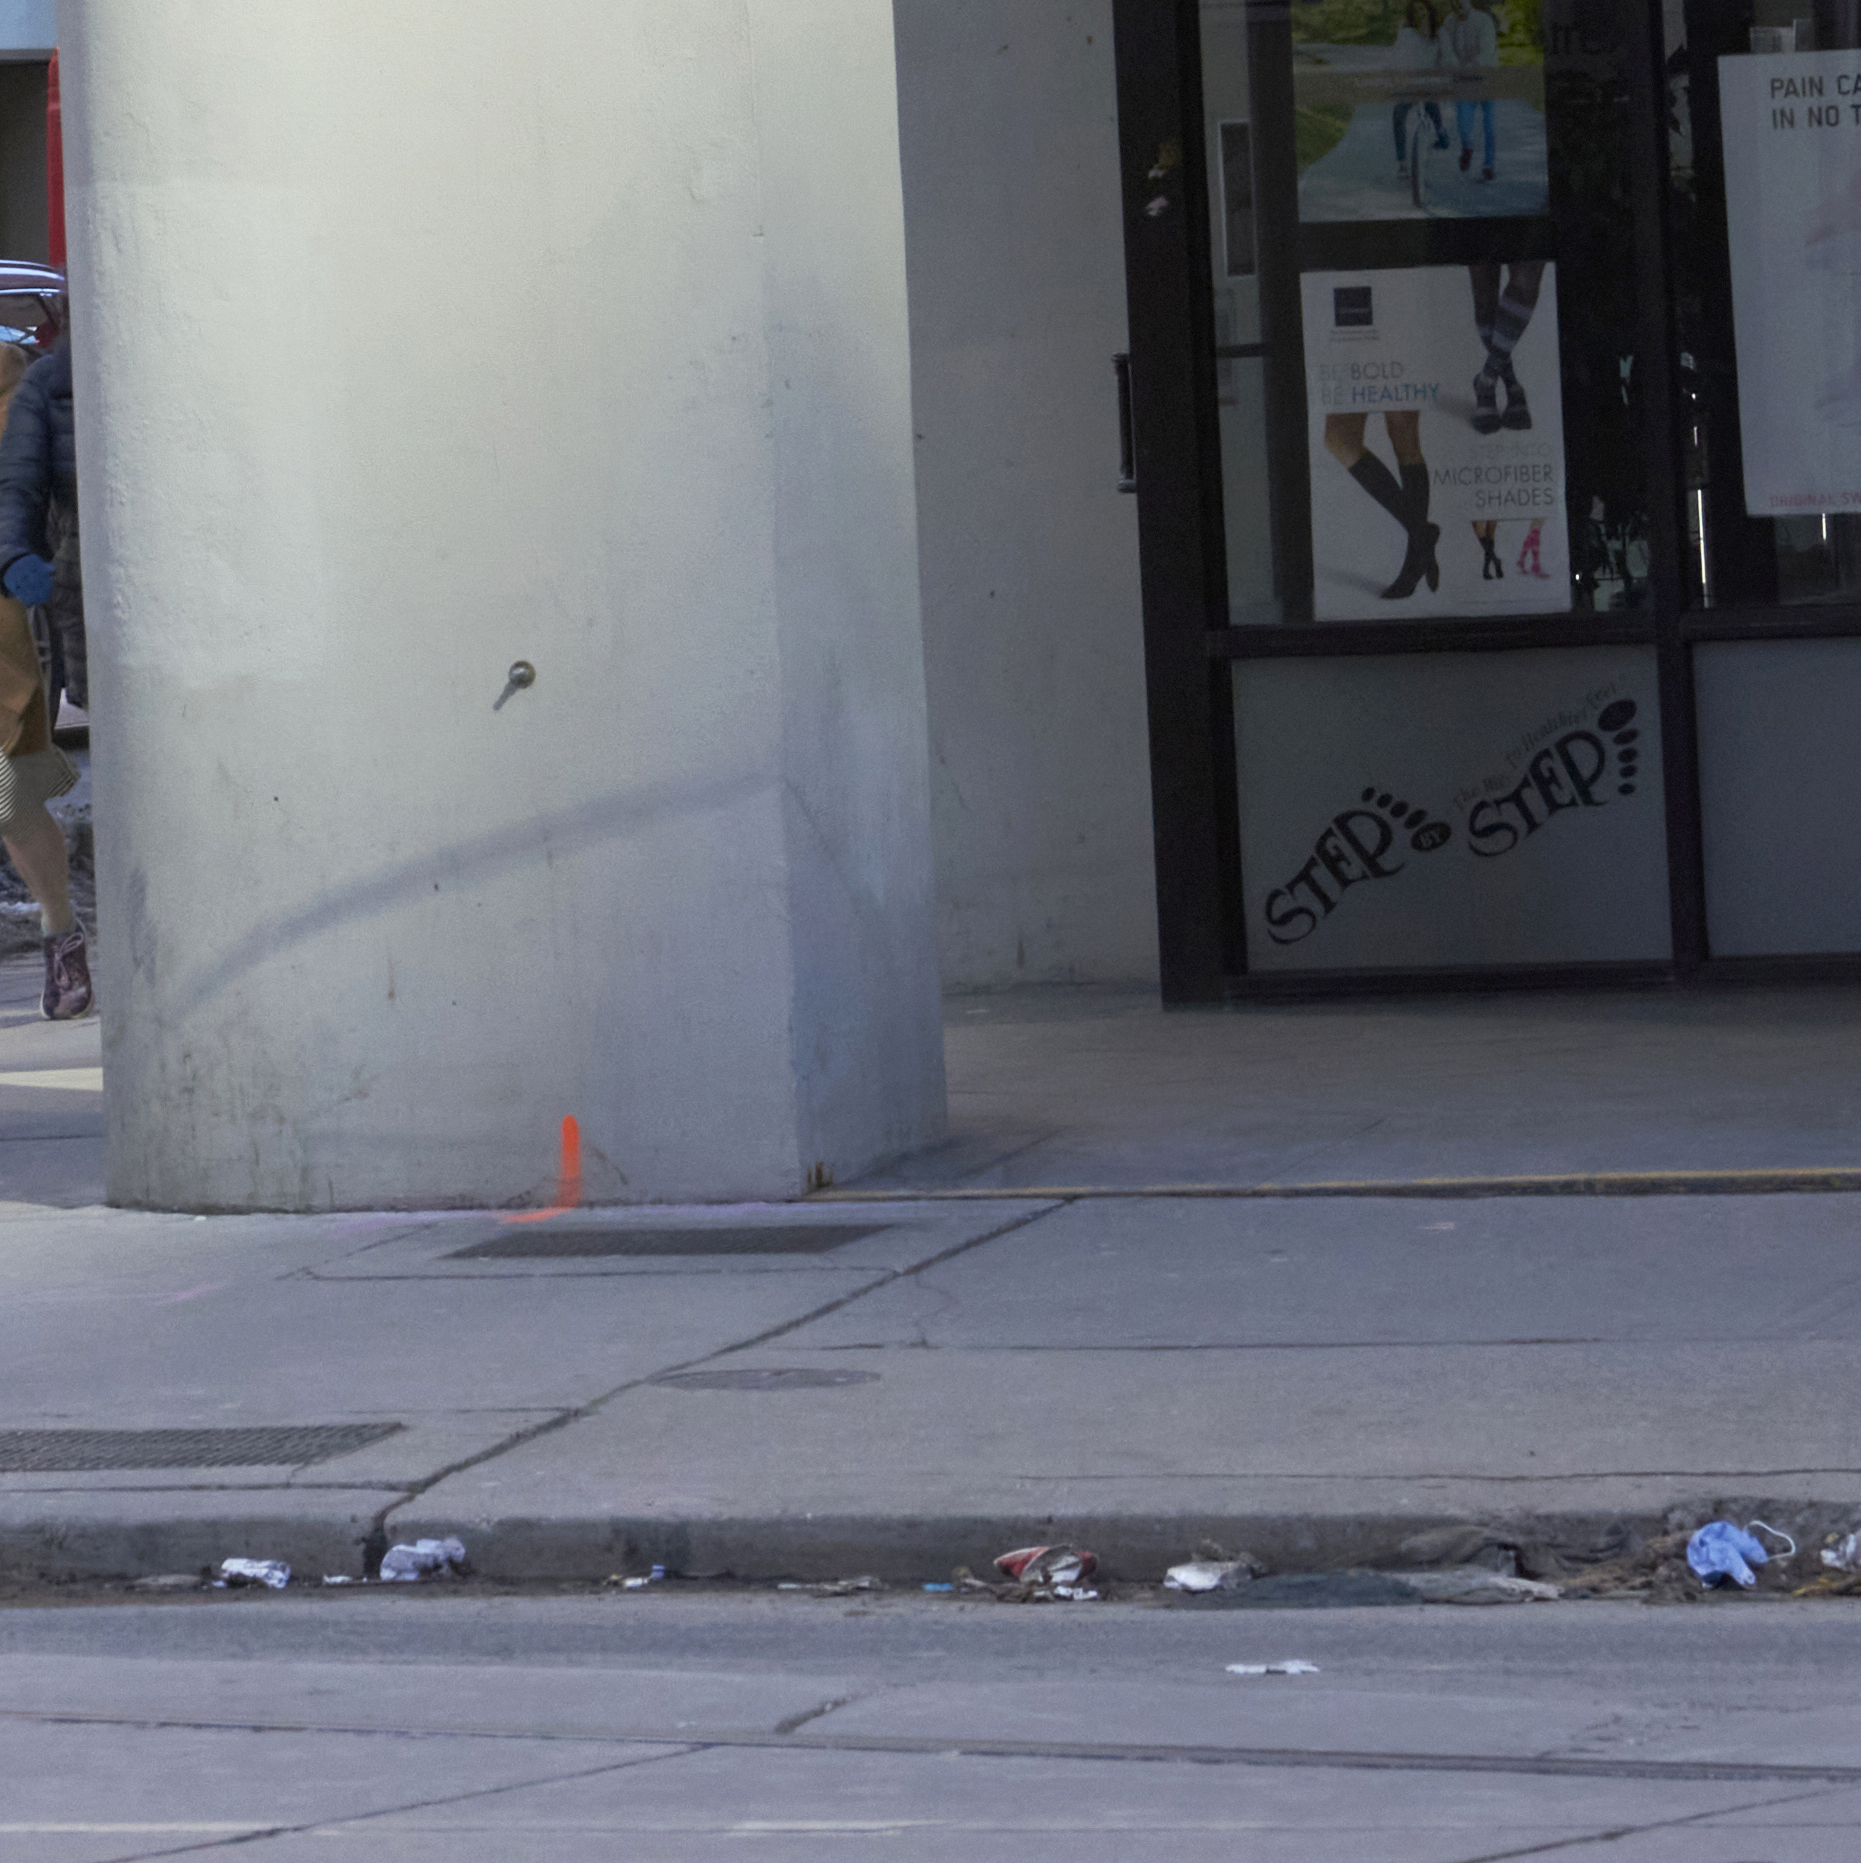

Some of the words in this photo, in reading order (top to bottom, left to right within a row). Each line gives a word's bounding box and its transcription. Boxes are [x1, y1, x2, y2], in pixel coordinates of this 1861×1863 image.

[1770, 76, 1824, 99] PAIN
[1772, 107, 1795, 129] IN
[1807, 105, 1840, 128] NO
[1350, 361, 1405, 381] BOLD
[1351, 382, 1441, 404] HEALTHY
[1433, 463, 1554, 486] MICROFIBER
[1475, 487, 1555, 509] SHADES
[1265, 809, 1407, 945] STEP
[1467, 730, 1609, 858] STEP
